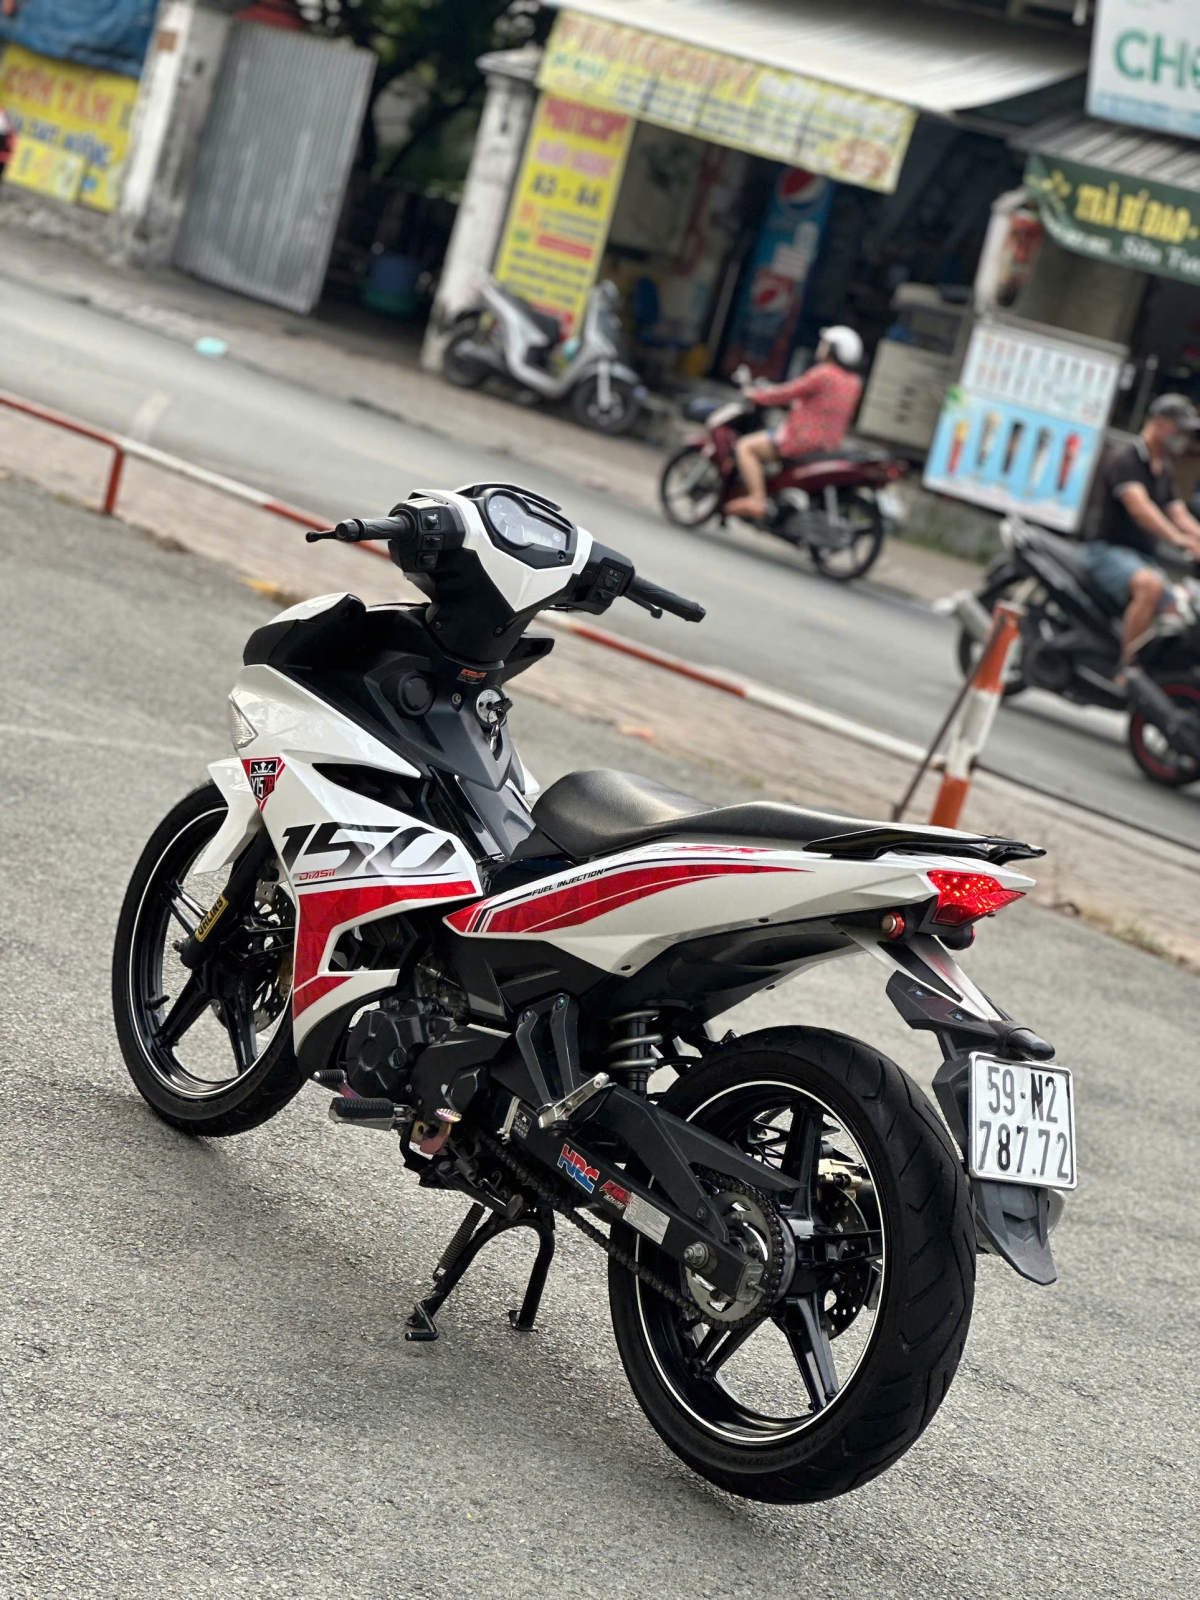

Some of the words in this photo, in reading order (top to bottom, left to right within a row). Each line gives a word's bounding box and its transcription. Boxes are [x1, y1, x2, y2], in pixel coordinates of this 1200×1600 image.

[282, 821, 457, 880] 150
[531, 884, 554, 897] FUEL
[556, 867, 605, 888] INJECTION
[556, 1143, 601, 1194] HRC
[977, 1119, 1070, 1180] 787.72
